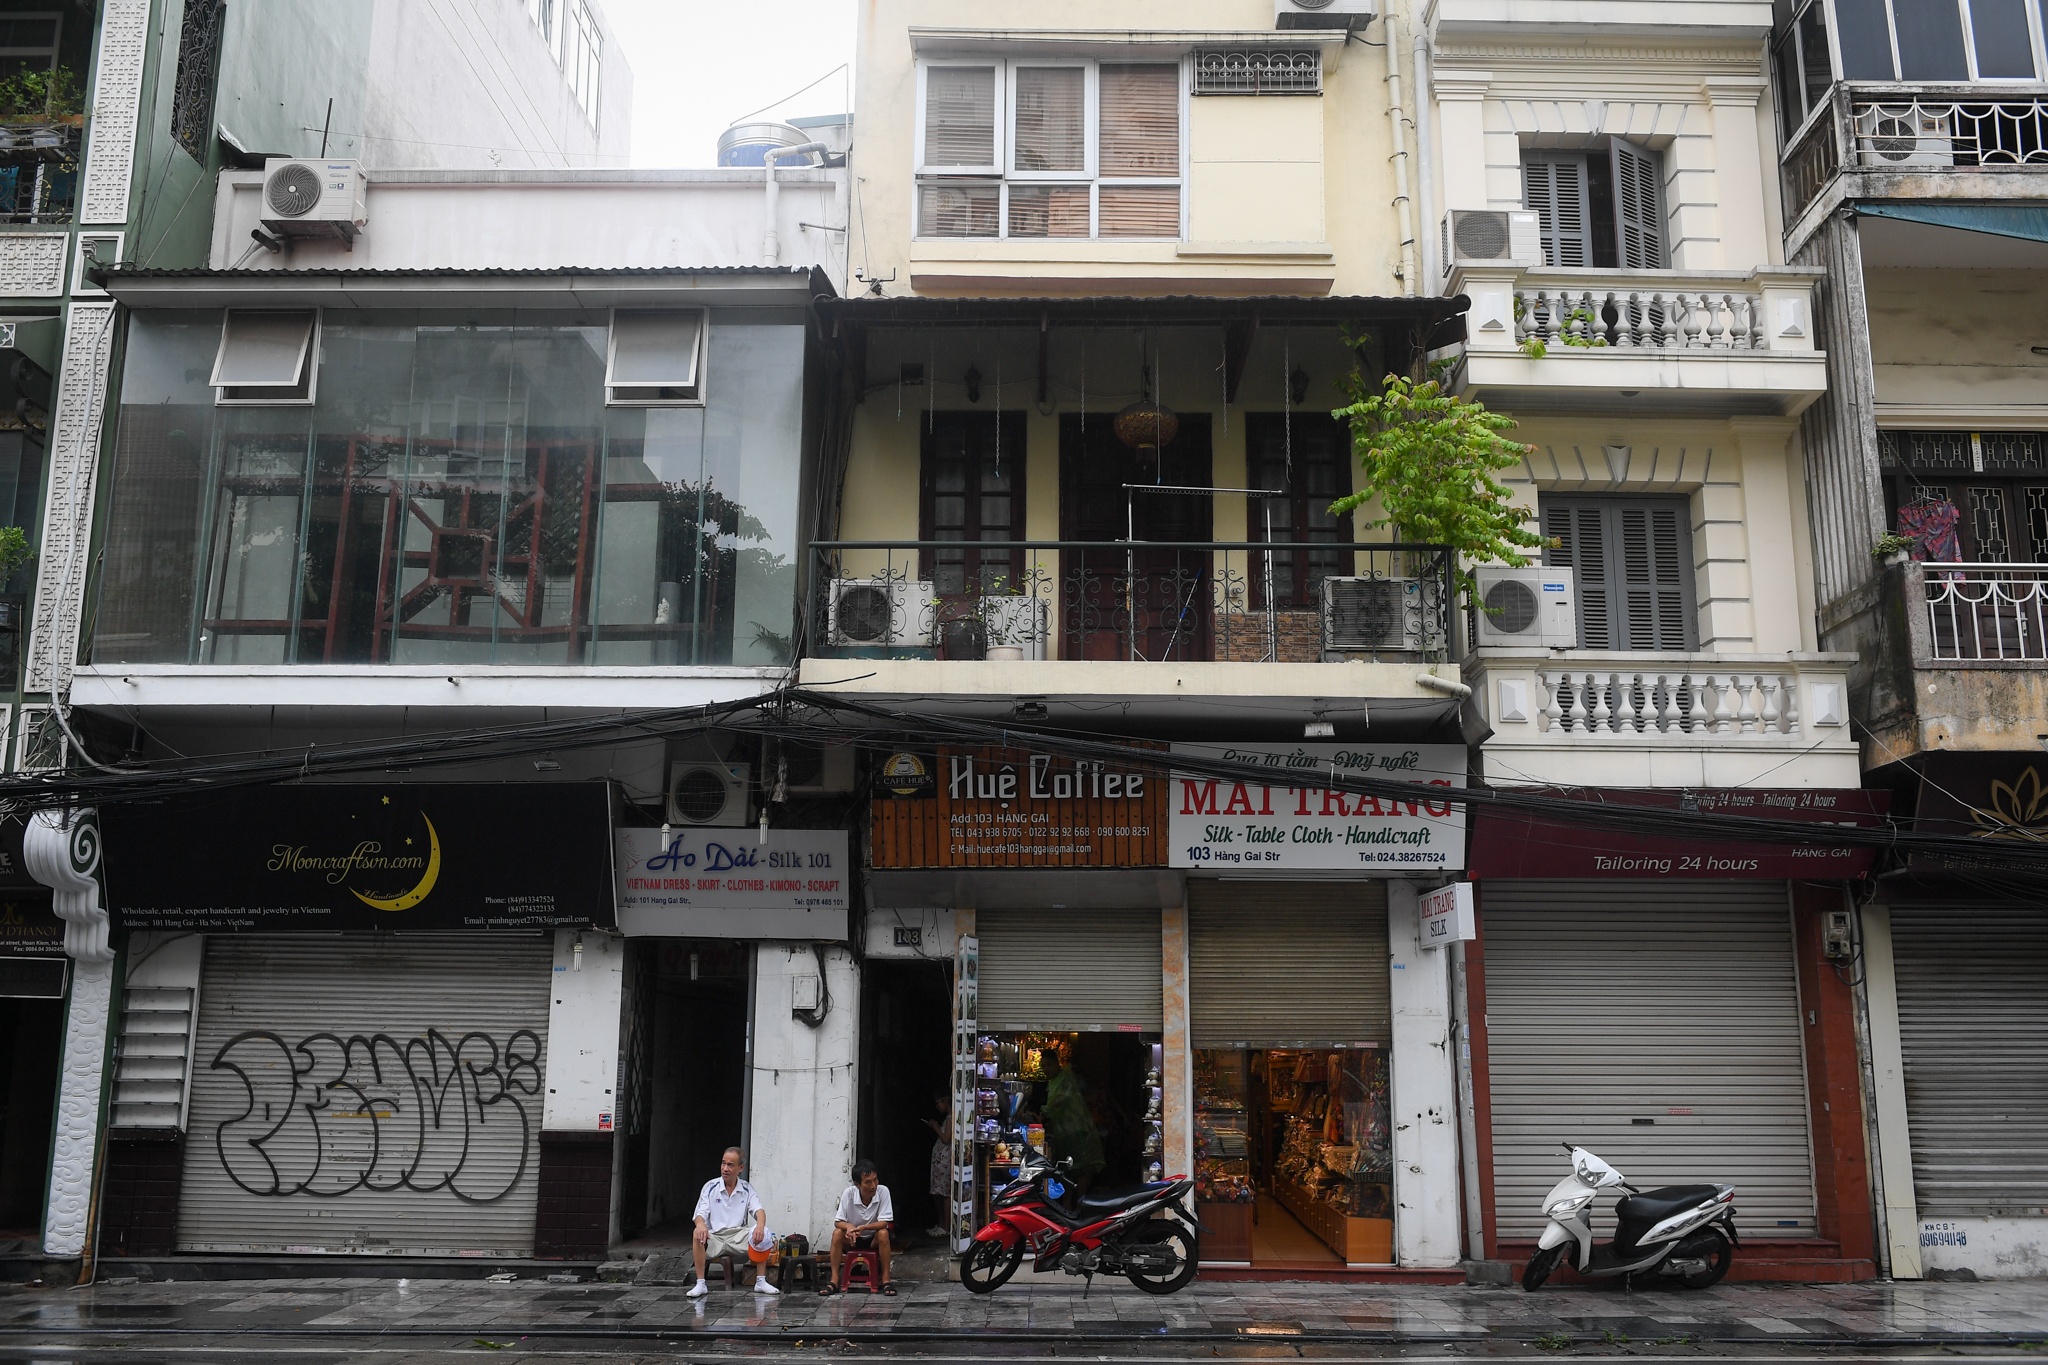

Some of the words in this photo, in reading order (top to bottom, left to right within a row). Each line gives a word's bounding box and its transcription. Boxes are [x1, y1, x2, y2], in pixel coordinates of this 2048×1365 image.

[1029, 754, 1144, 800] Coffee
[1179, 778, 1274, 815] MAI
[1718, 793, 1730, 806] 24
[1731, 792, 1755, 806] hours
[1762, 793, 1796, 810] Tailoring
[1800, 793, 1812, 806] 24
[1813, 793, 1837, 806] hours
[996, 811, 1028, 824] HÀNG
[1030, 813, 1049, 823] GAI
[966, 828, 982, 838] 043
[985, 828, 1000, 838] 938
[1002, 827, 1022, 838] 6705
[1028, 827, 1047, 837] 0122
[1050, 827, 1060, 837] 92
[1062, 827, 1072, 837] 92
[1074, 826, 1090, 837] 668
[1097, 826, 1113, 836] 090
[1115, 826, 1130, 836] 600
[1132, 826, 1150, 836] 8251
[1203, 824, 1234, 844] Silk
[1245, 824, 1286, 844] Table
[1292, 824, 1334, 844] Cloth
[1344, 825, 1432, 847] Handicraft
[646, 833, 696, 872] Áo
[704, 842, 758, 872] Dài
[768, 852, 802, 868] Silk
[807, 852, 832, 868] 101
[950, 844, 956, 854] E
[1186, 846, 1211, 861] 103
[1214, 850, 1240, 863] Hàng
[1244, 851, 1262, 862] Gai
[1265, 851, 1281, 862] Str
[1831, 848, 1852, 858] GAI
[266, 840, 425, 885] Mooncraftsvn.com
[1594, 856, 1672, 874] Tailoring
[1678, 856, 1702, 871] 24
[1706, 856, 1758, 871] hours
[626, 878, 662, 891] VIETNAM
[663, 878, 690, 891] DRESS
[696, 878, 720, 891] SKIRT
[727, 879, 764, 891] CLOTHES
[770, 880, 801, 892] KIMONO
[808, 880, 840, 892] SCRAPT
[364, 888, 408, 900] Handmade
[484, 896, 507, 904] Phone:
[508, 896, 554, 905] (84)913347524
[624, 896, 638, 904] Add:
[640, 896, 650, 904] 101
[651, 896, 667, 906] Hang
[121, 907, 162, 916] Wholesale,
[162, 907, 184, 916] retail,
[185, 908, 208, 916] export
[210, 906, 246, 914] handicraft
[248, 906, 261, 914] and
[262, 907, 290, 916] jewelry
[300, 906, 332, 914] Vietnam
[508, 904, 555, 914] (84)774322135
[1420, 898, 1433, 919] MAI
[1432, 891, 1454, 916] TRANG
[122, 919, 150, 927] Address:
[164, 919, 182, 928] Hang
[226, 918, 255, 927] VietNam
[464, 916, 487, 925] Email:
[6, 926, 57, 936] D'HANOI
[1430, 918, 1448, 938] SILK
[896, 930, 919, 944] 103
